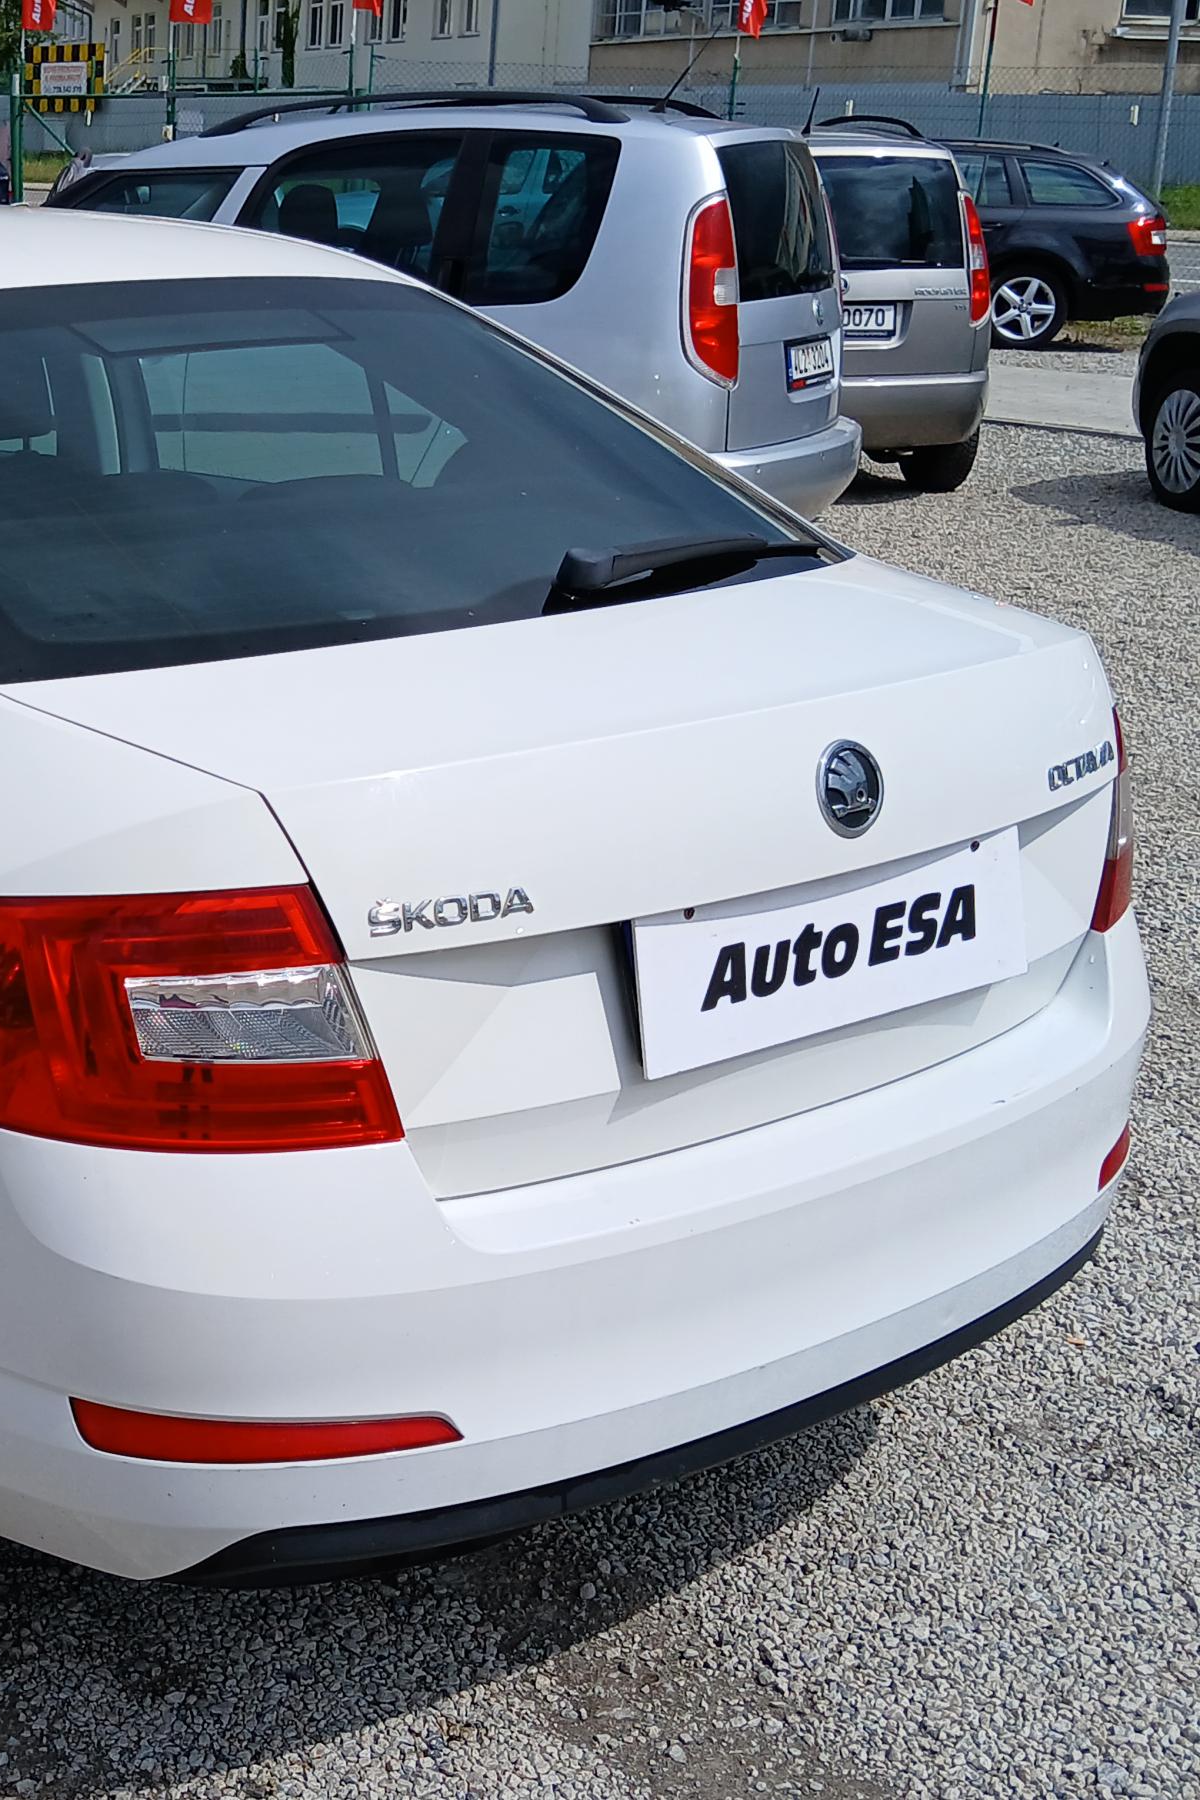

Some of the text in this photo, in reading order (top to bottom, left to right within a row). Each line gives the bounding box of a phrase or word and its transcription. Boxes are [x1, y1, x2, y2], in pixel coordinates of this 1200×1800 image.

[367, 886, 535, 938] ŠKODA
[700, 883, 977, 1013] Auto ESA
